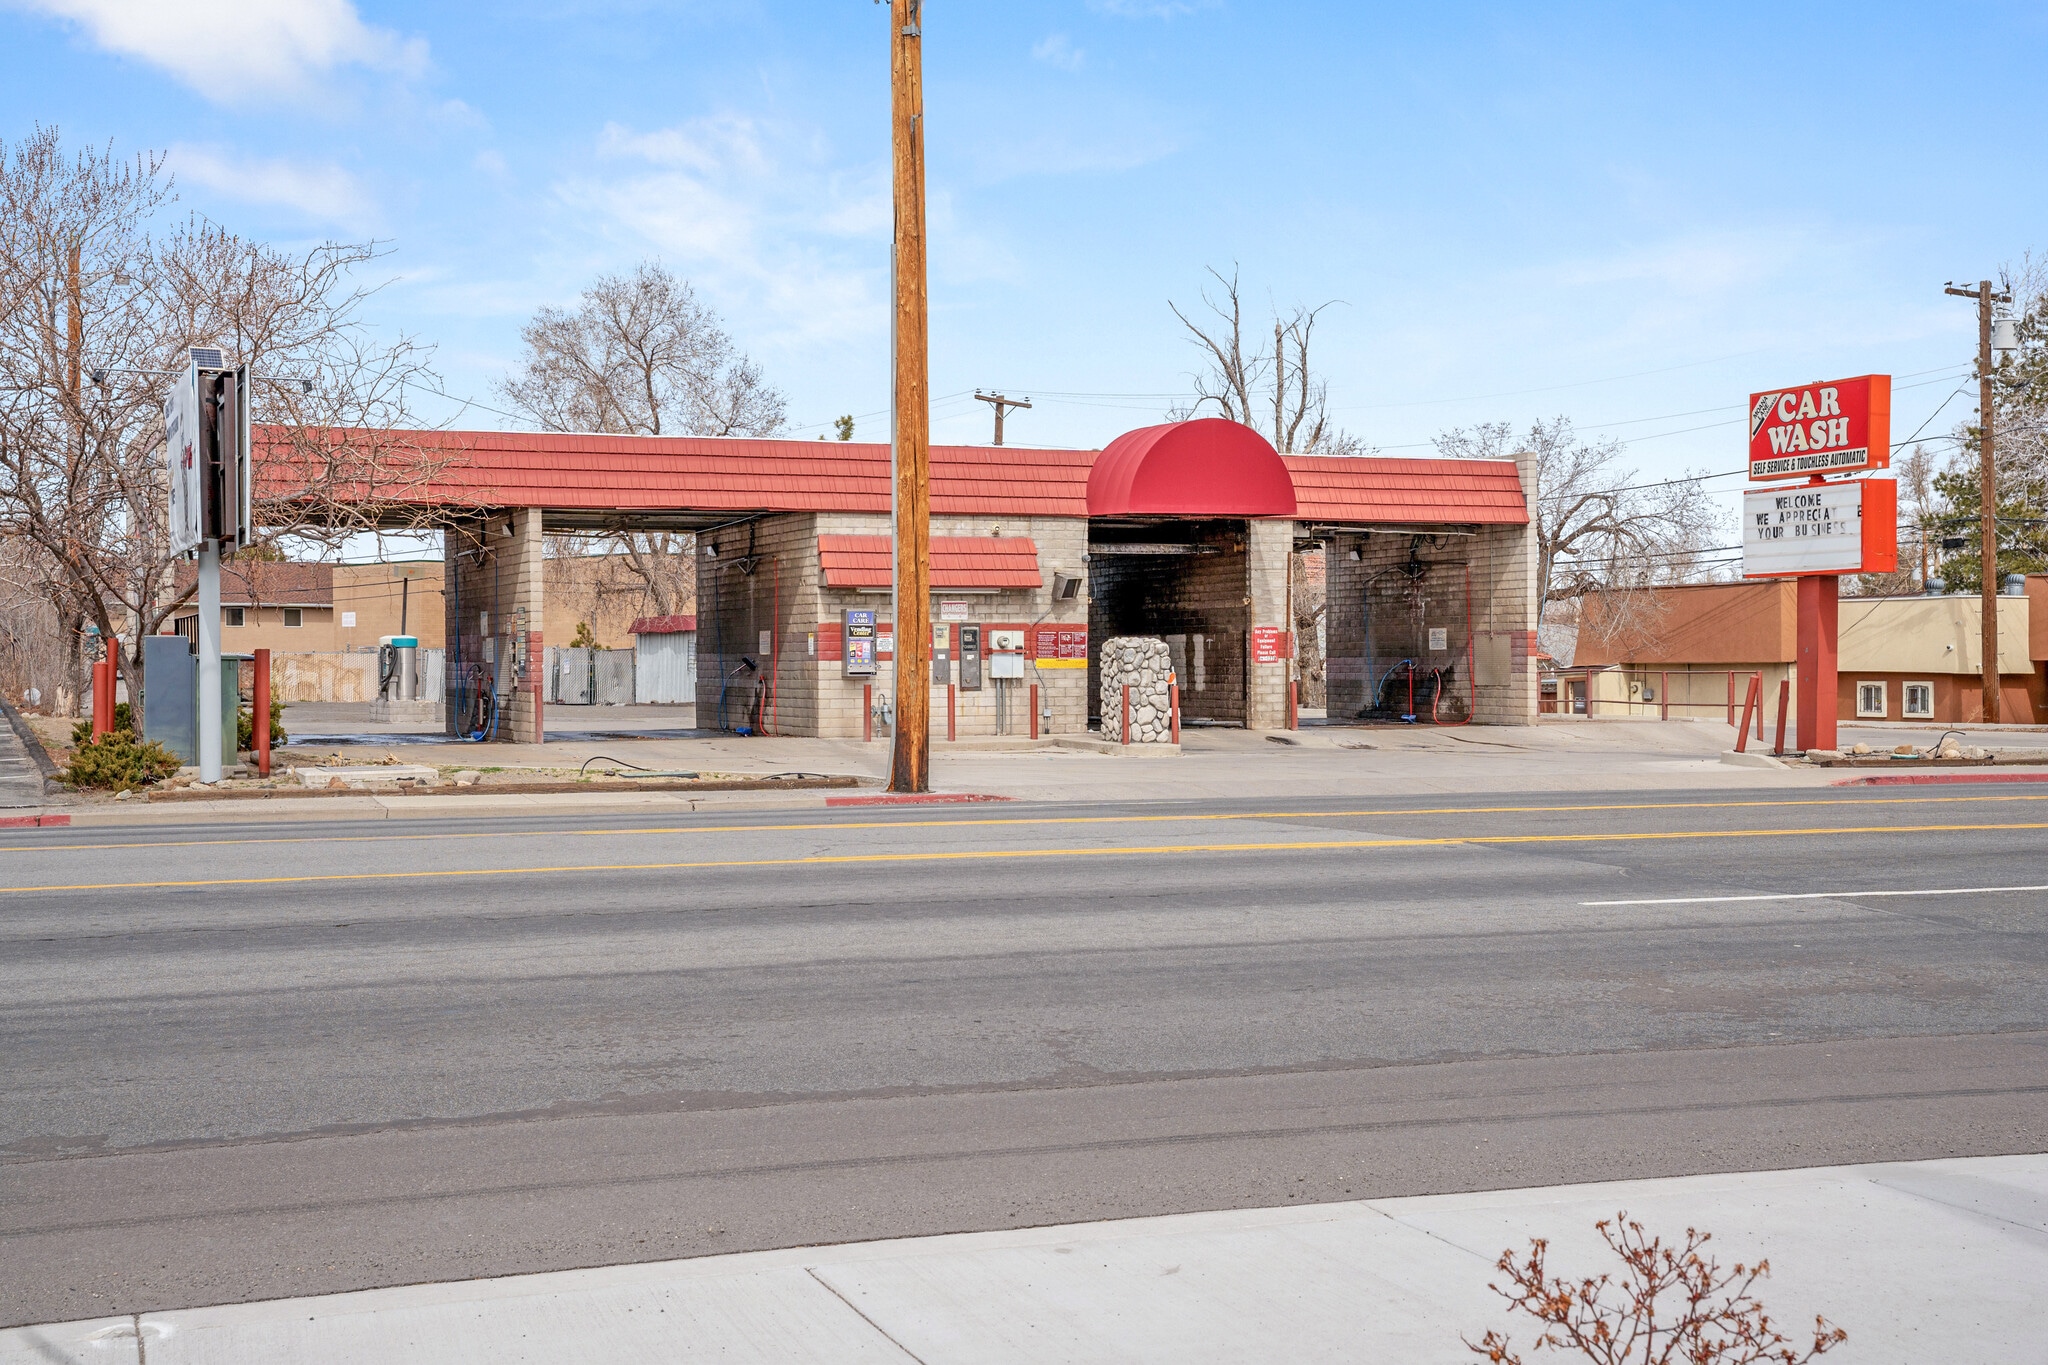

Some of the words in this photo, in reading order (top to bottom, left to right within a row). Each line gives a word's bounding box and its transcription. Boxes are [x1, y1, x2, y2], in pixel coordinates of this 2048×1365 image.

[1753, 396, 1768, 419] MOANA
[1757, 402, 1769, 420] LANE
[1777, 386, 1841, 423] CAR
[1767, 416, 1850, 455] WASH
[1753, 461, 1766, 475] SELF
[1767, 458, 1790, 473] SERVICE
[1791, 458, 1796, 470] &
[1797, 453, 1829, 470] TOUCHLESS
[1830, 449, 1866, 466] AUTOMATIC
[1776, 493, 1822, 510] WELCOME
[1756, 513, 1769, 526] WE
[1758, 526, 1784, 540] YOUR
